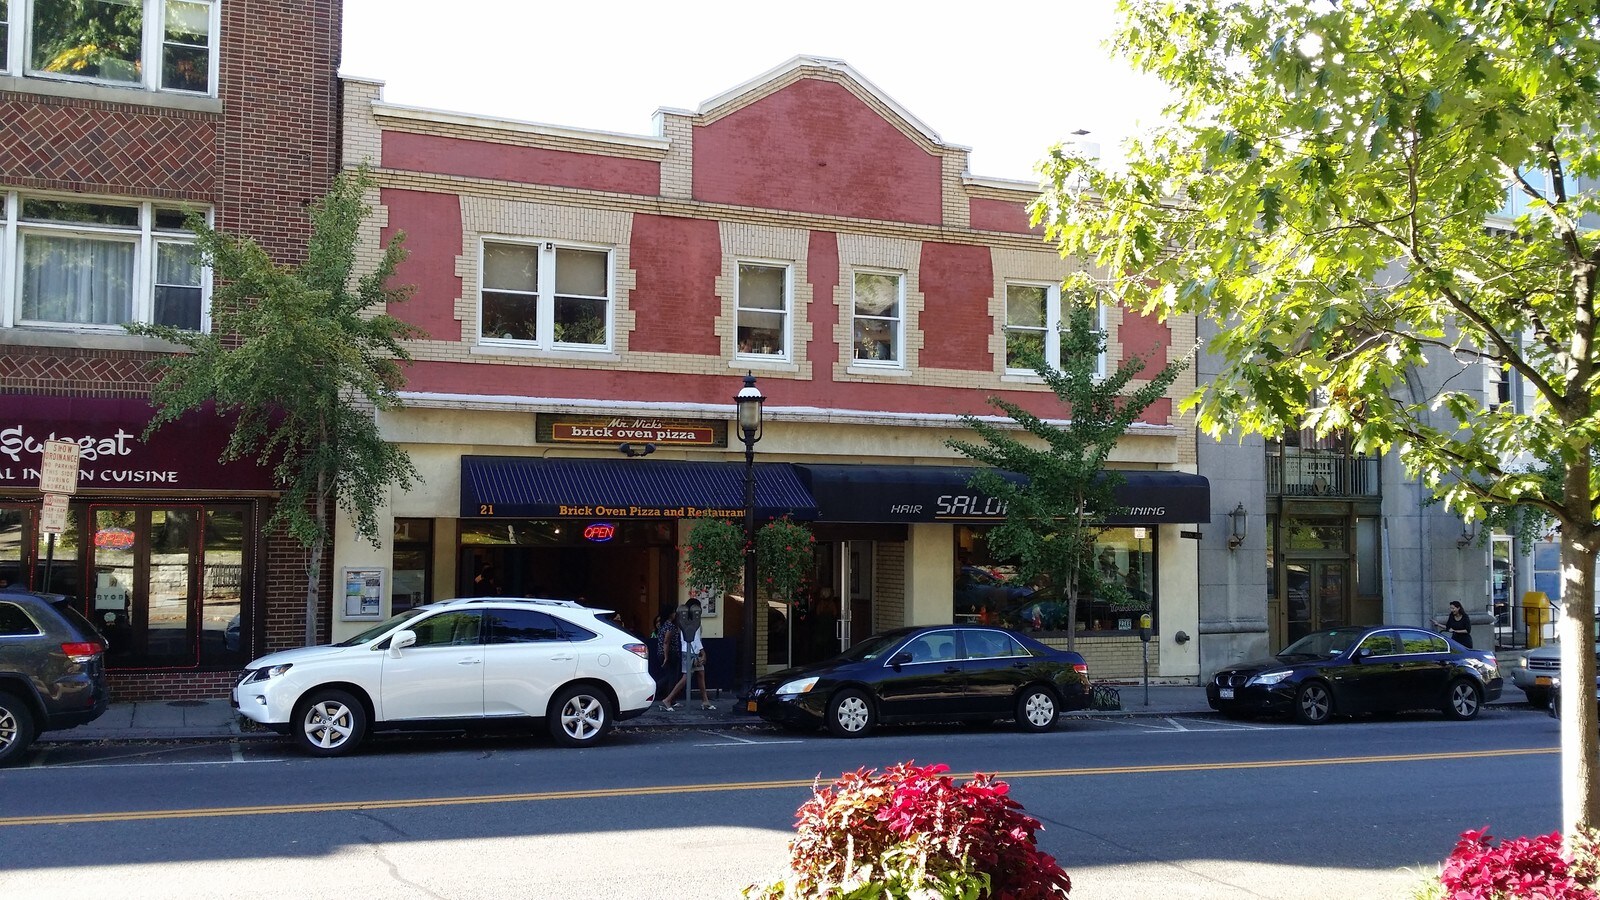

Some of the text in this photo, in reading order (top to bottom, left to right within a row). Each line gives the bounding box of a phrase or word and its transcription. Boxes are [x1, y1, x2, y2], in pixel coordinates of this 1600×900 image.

[607, 418, 662, 429] Mr. Nick's
[571, 426, 696, 441] brick oven pizza
[53, 444, 73, 453] SNOW
[44, 452, 77, 463] ORDINANCE
[100, 469, 178, 482] CUISINE
[480, 504, 494, 515] 21
[559, 505, 593, 516] Brick
[595, 506, 627, 516] Oven
[629, 506, 661, 517] Pizza
[663, 507, 685, 517] and
[890, 504, 923, 514] HAIR
[584, 526, 614, 538] OPEN
[94, 532, 135, 546] OPEN
